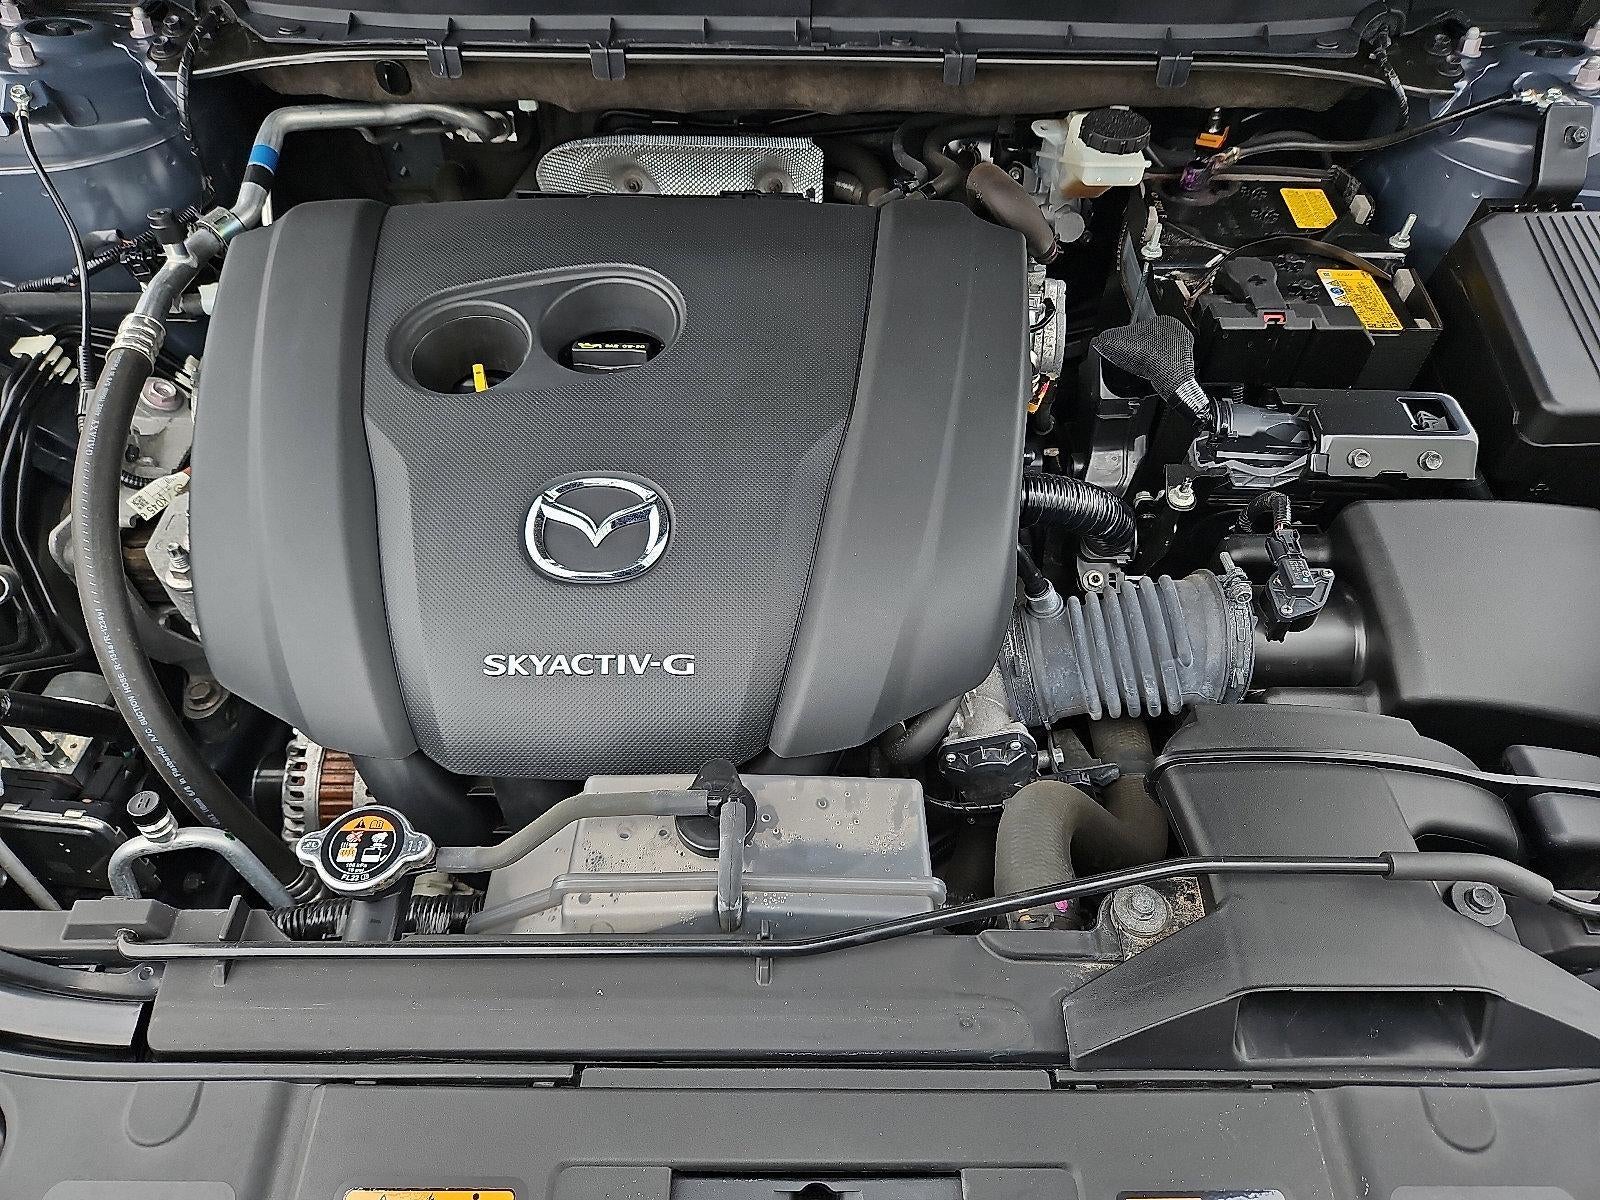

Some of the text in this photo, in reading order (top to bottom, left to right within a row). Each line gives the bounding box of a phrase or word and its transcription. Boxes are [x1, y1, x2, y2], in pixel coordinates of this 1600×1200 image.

[85, 419, 100, 456] GALAXY
[482, 653, 696, 677] SKYACTIV-G
[117, 672, 132, 694] HOSE
[127, 695, 148, 727] SUCTION
[145, 727, 159, 743] A/C
[340, 873, 359, 881] FL22
